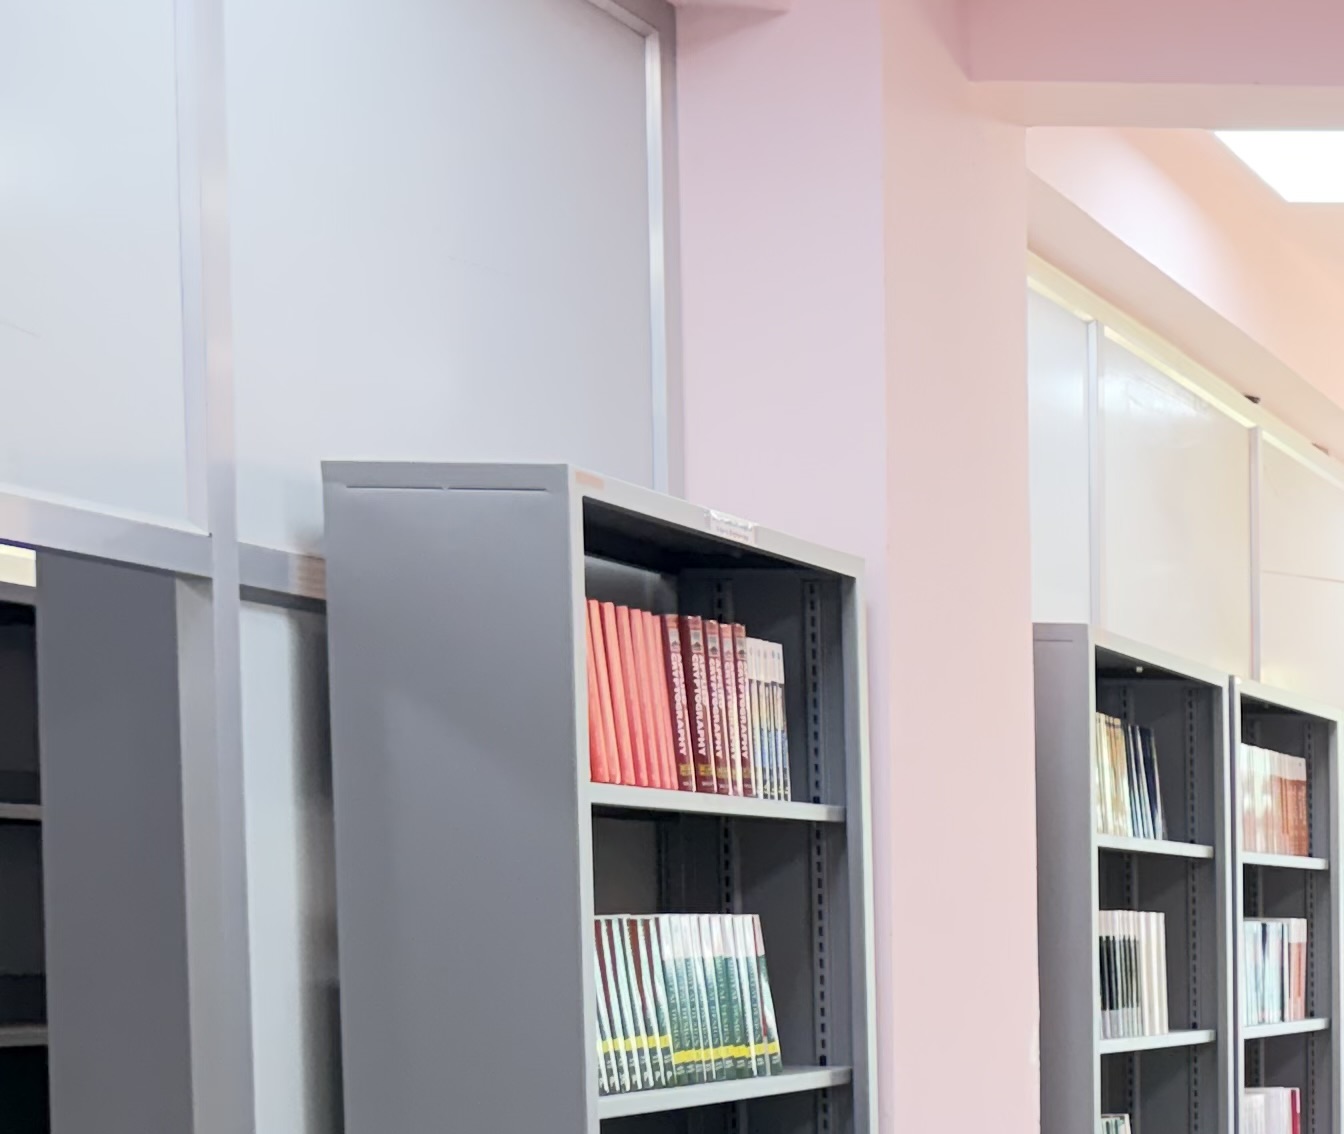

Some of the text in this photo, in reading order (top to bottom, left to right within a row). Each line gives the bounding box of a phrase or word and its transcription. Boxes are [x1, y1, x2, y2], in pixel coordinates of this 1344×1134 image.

[671, 653, 686, 756] CRYPTOGRAPHY
[692, 654, 706, 756] CRYPTOGRAPHY
[709, 658, 722, 759] CRYPTOGRAPHY
[737, 660, 748, 759] CRYPTOGRAPHY
